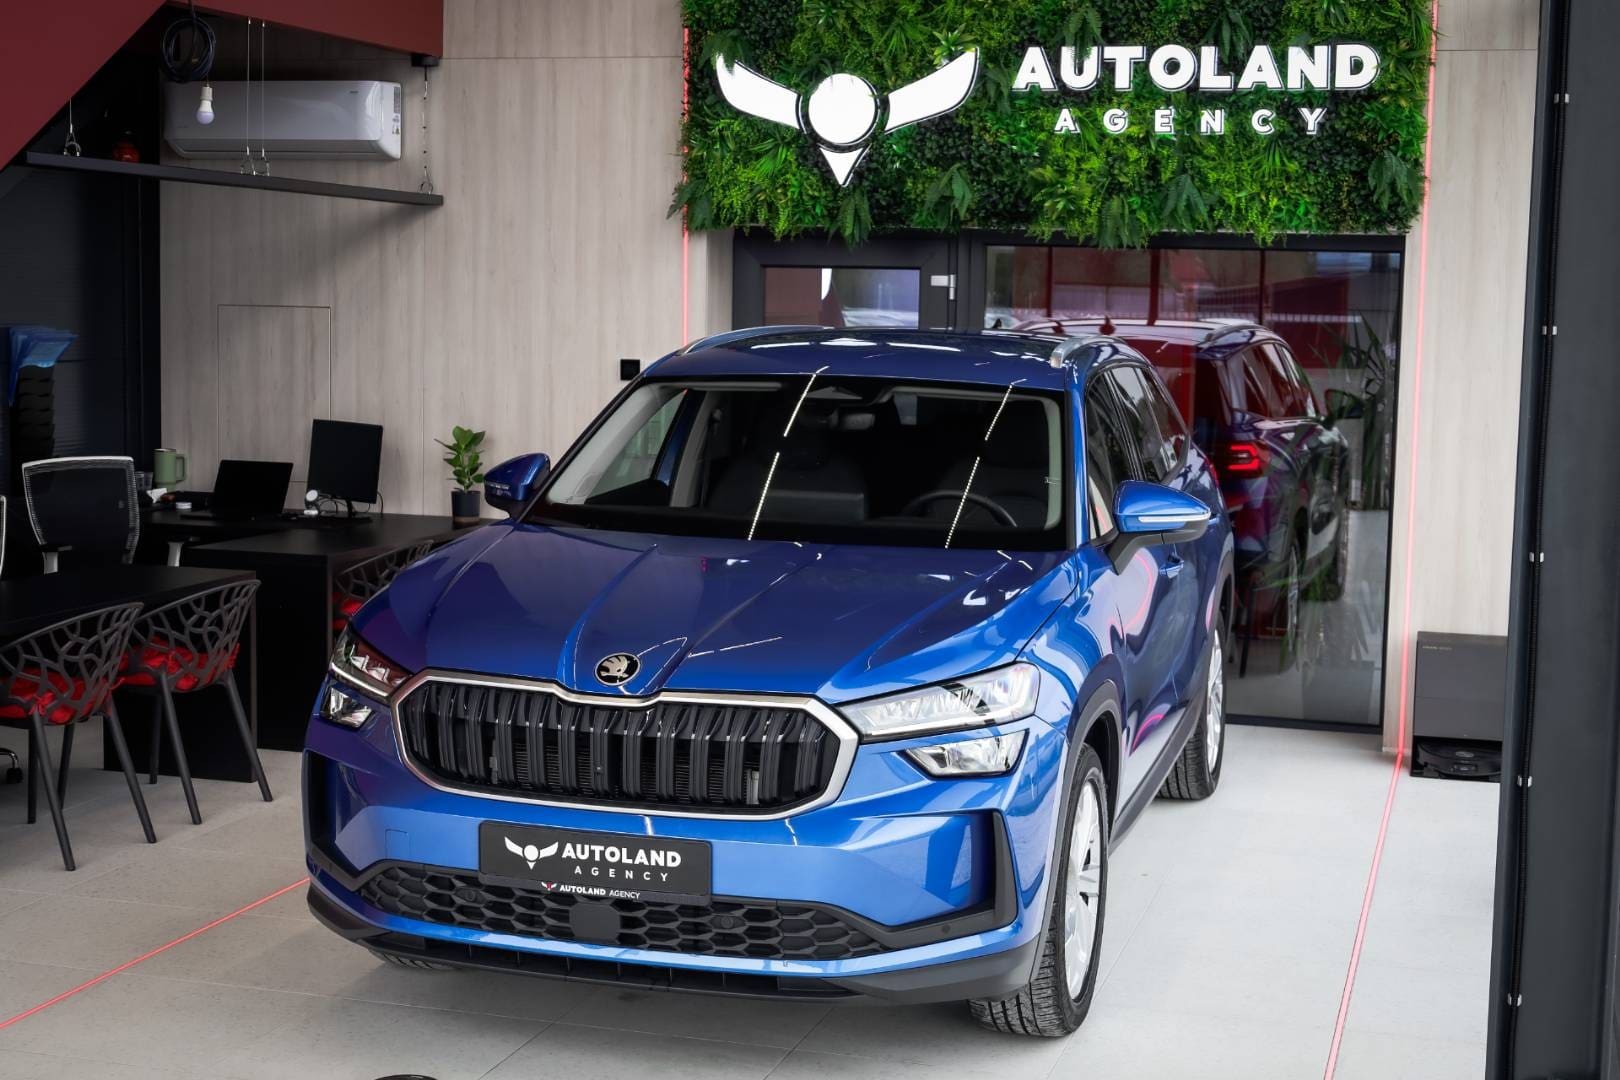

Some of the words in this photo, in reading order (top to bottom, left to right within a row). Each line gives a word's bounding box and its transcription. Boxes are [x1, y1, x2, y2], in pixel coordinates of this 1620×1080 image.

[1012, 44, 1380, 91] AUTOLAND
[1054, 107, 1327, 134] AGENCY
[561, 842, 682, 868] AUTOLAND
[574, 865, 669, 882] AGENCY
[559, 884, 606, 896] AUTOLAND
[608, 889, 640, 900] AGENCY
